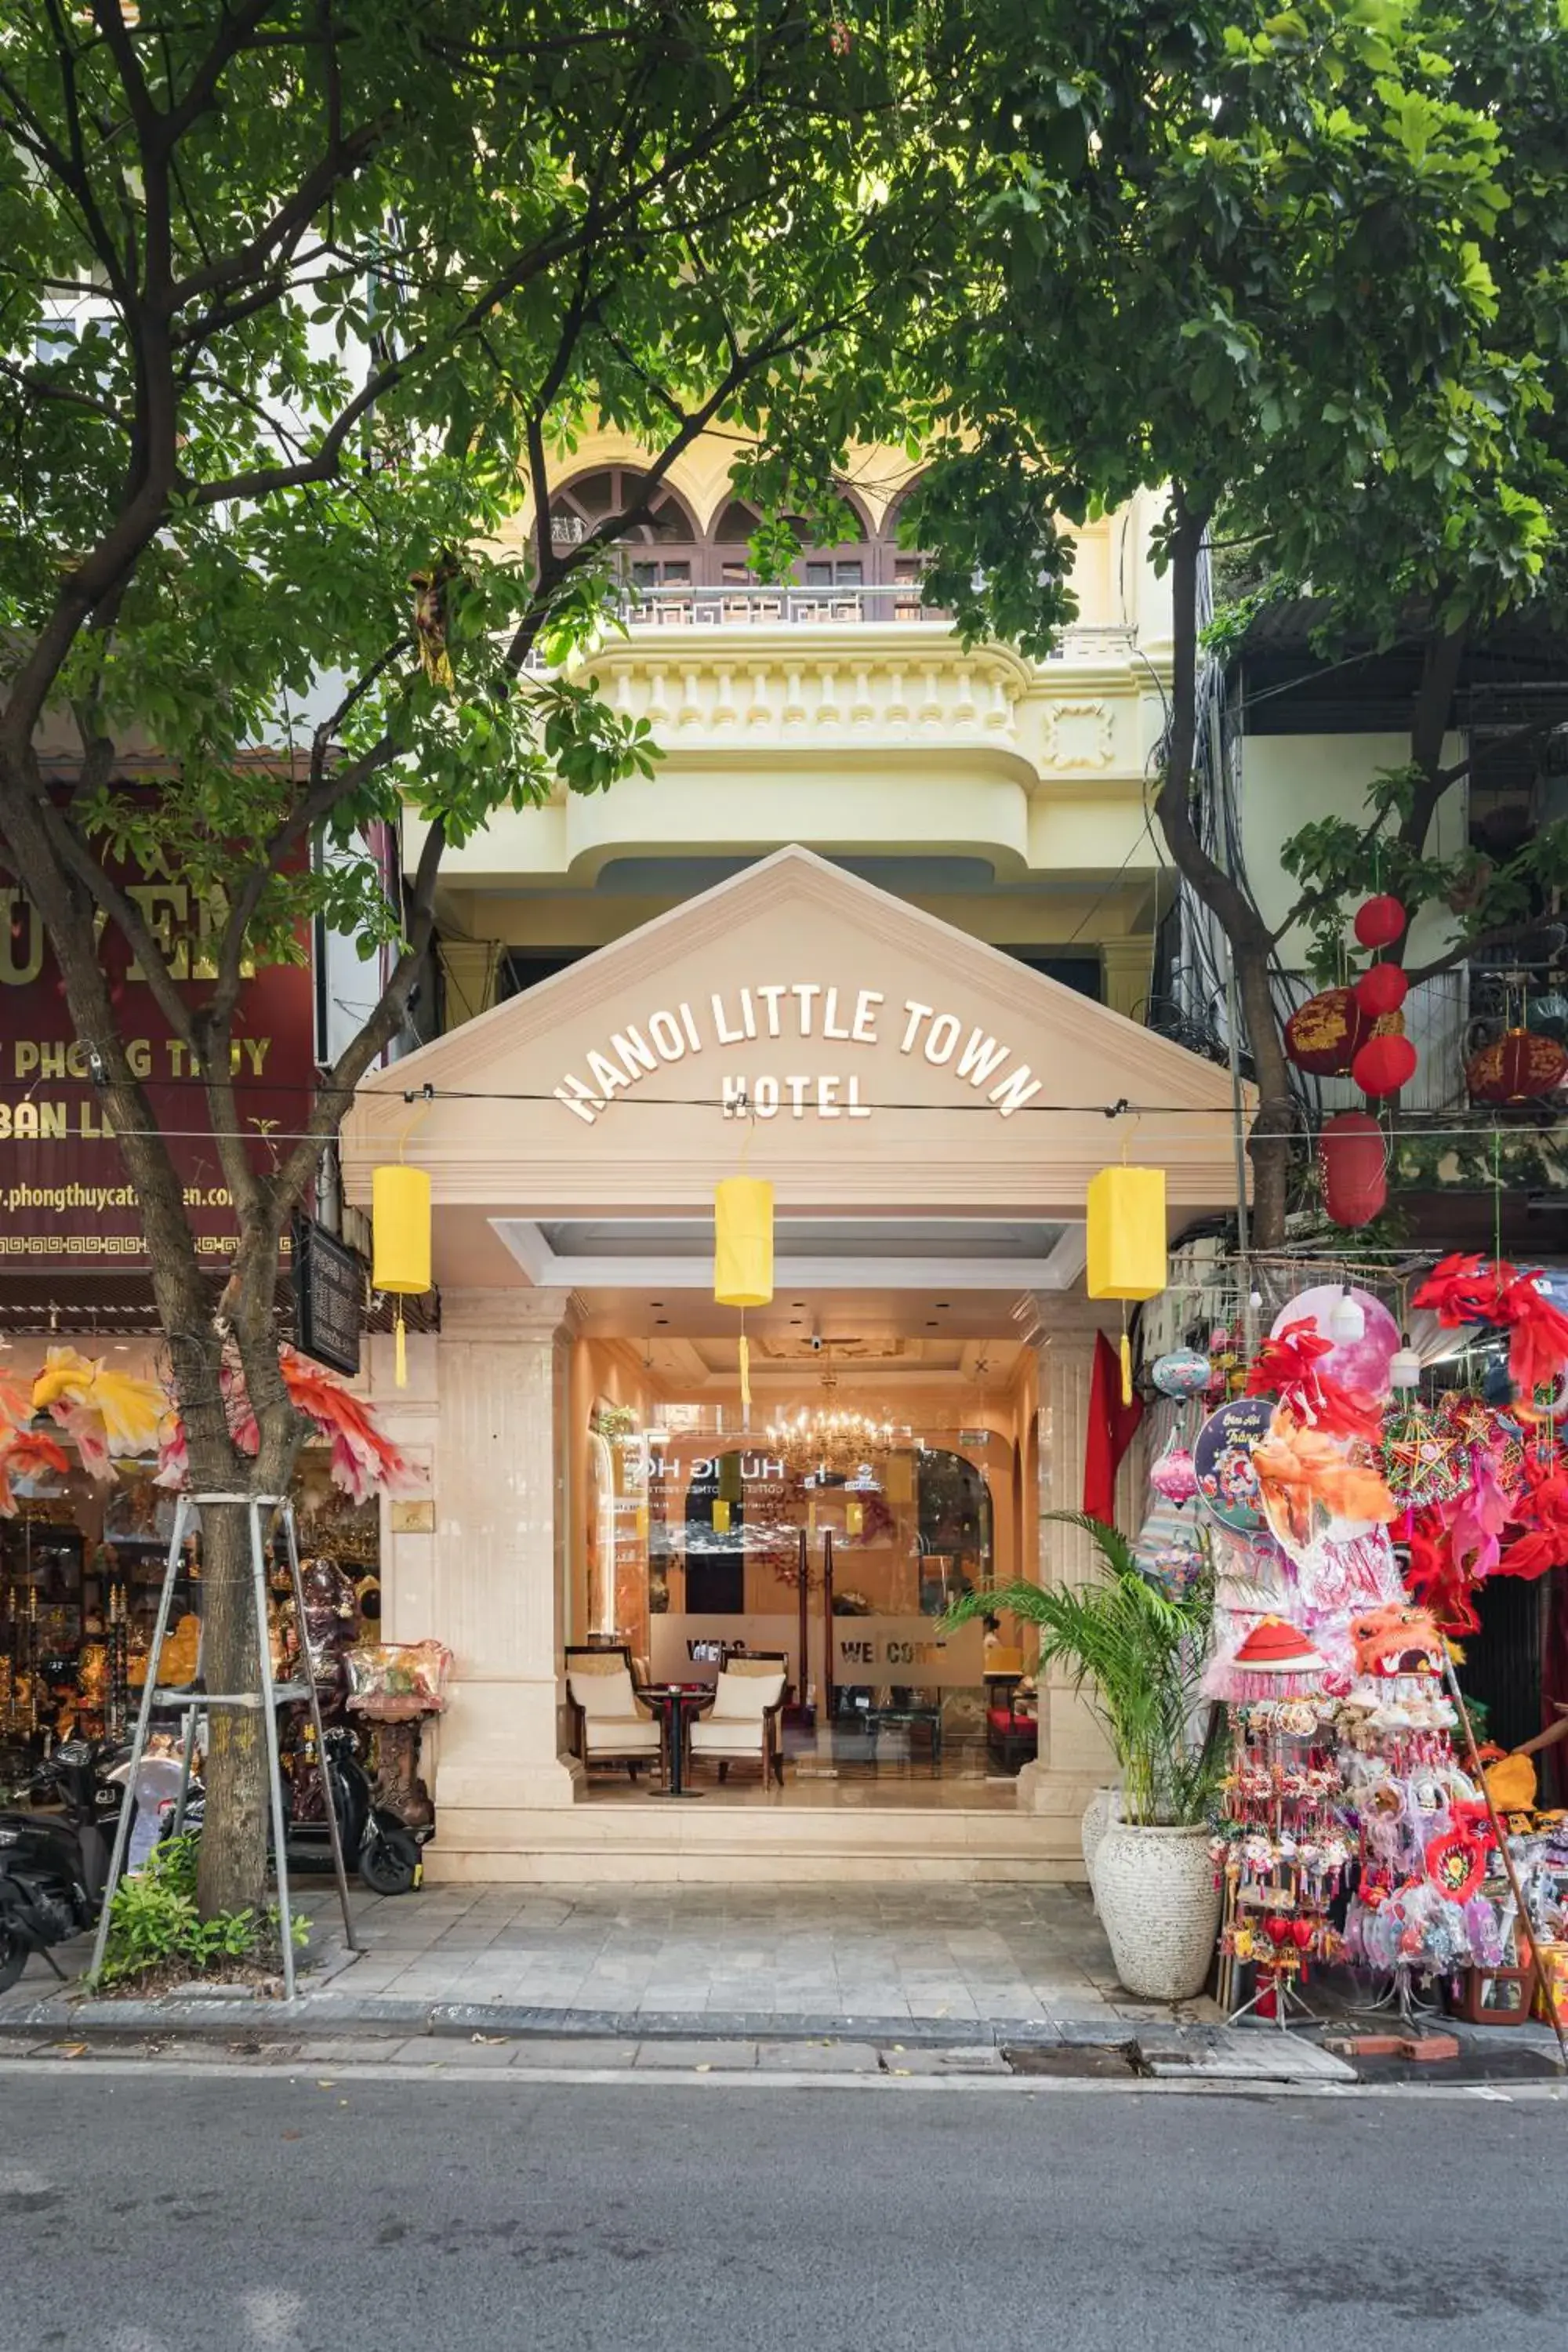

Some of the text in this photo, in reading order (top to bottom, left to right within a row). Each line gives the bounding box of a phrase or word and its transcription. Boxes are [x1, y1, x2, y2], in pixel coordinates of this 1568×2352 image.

[15, 1040, 151, 1079] PHOG
[553, 983, 1043, 1124] HANOI LITTLE TOWN
[721, 1075, 872, 1119] HOTEL
